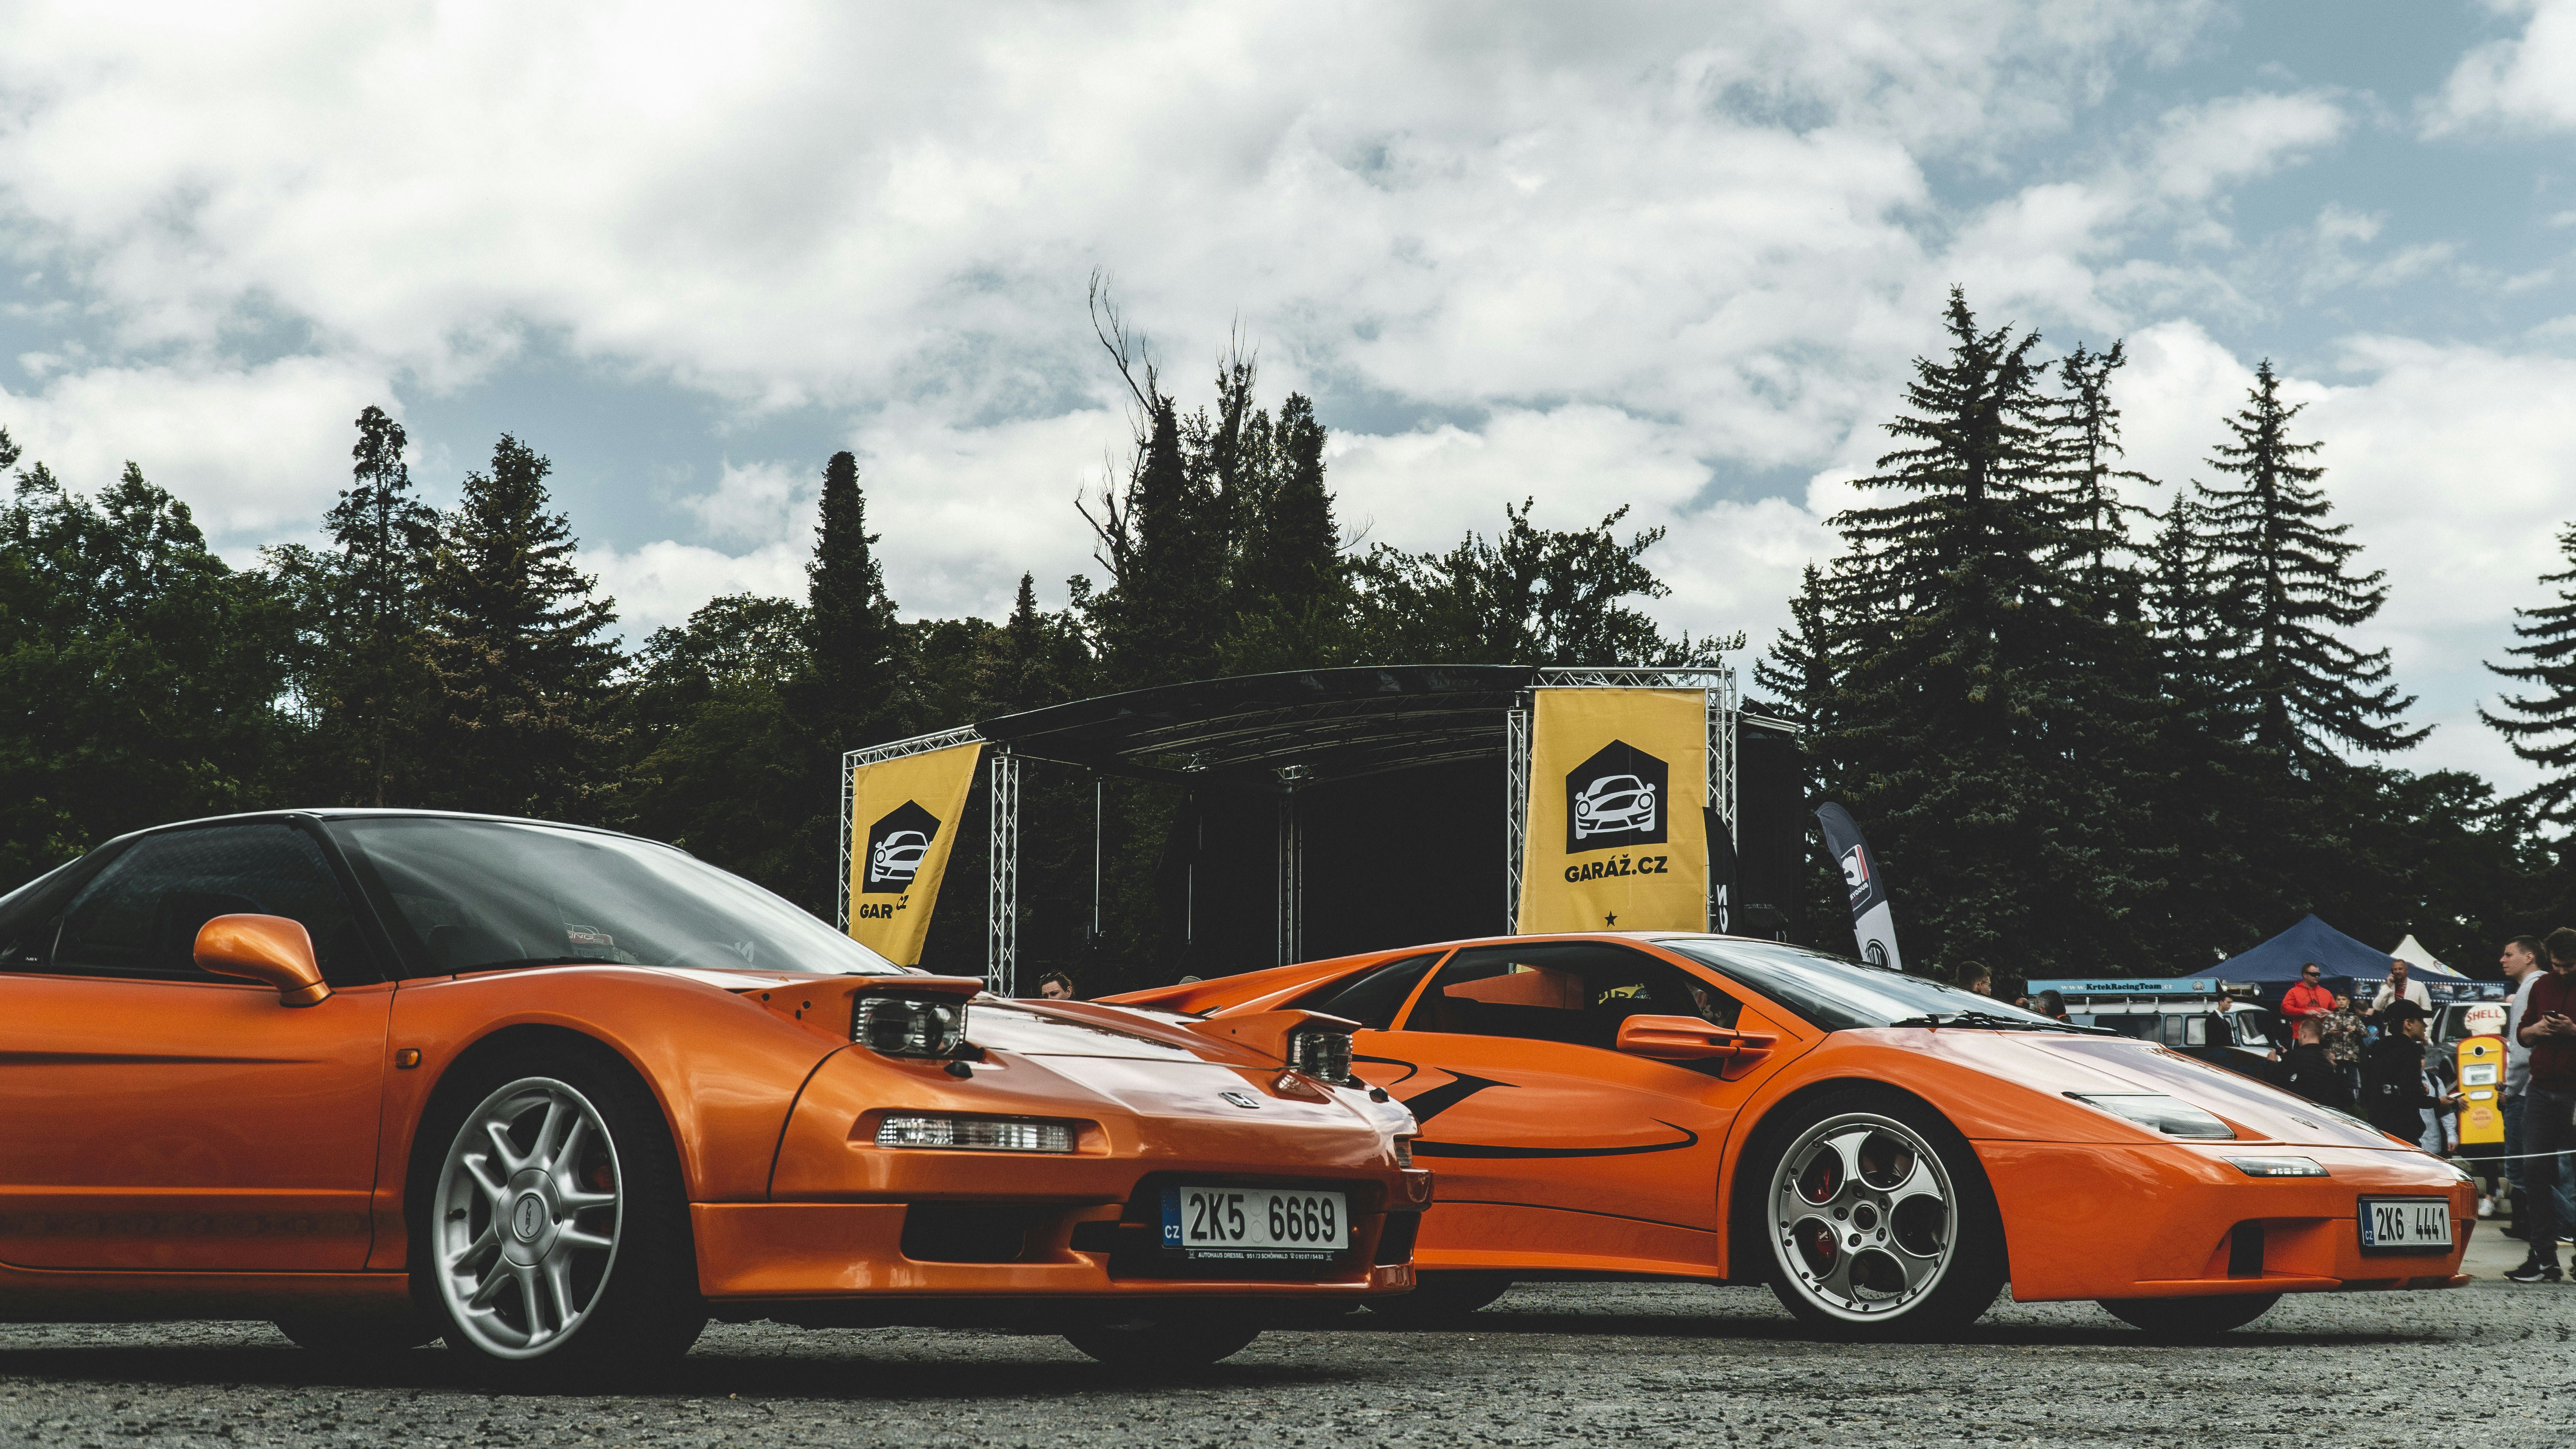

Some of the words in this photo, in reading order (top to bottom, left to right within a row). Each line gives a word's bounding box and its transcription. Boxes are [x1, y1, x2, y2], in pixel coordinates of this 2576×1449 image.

[1564, 854, 1668, 883] GARÁŽ.CZ
[2467, 1009, 2501, 1022] SHELL
[1189, 1193, 1245, 1240] 2K5
[1269, 1195, 1336, 1242] 6669
[2376, 1207, 2404, 1240] 2K6
[2416, 1207, 2446, 1240] 4441
[1165, 1225, 1180, 1239] CZ
[2365, 1230, 2373, 1240] CZ
